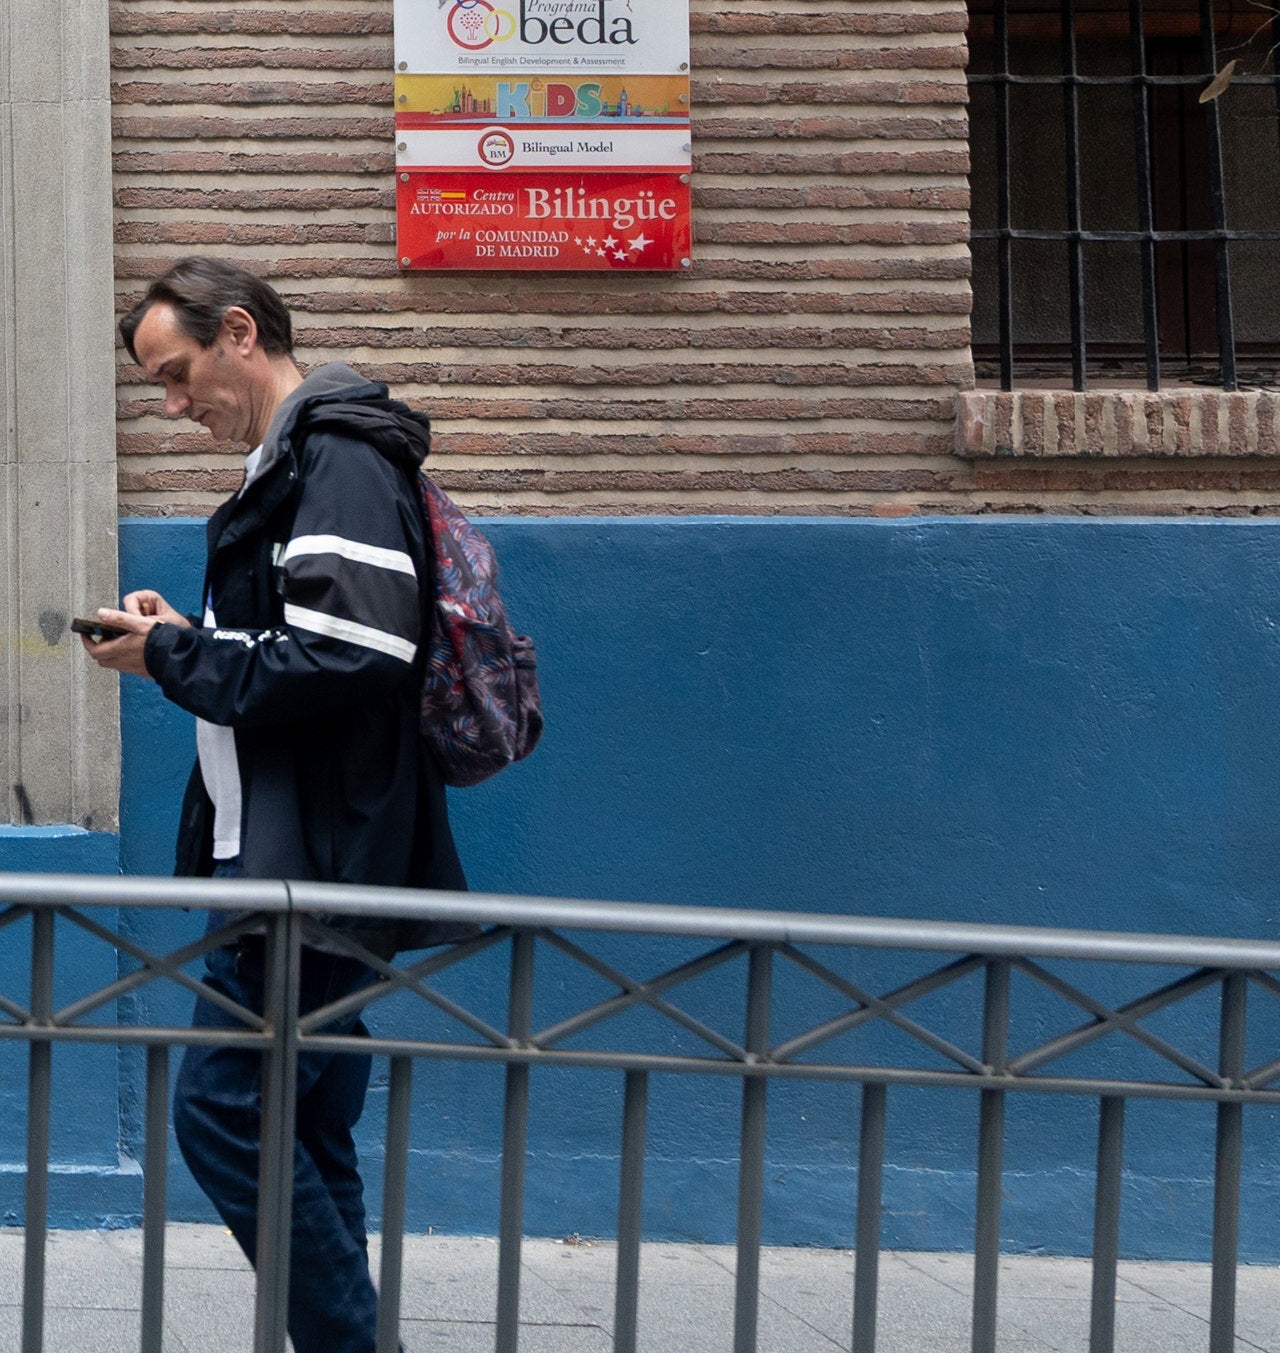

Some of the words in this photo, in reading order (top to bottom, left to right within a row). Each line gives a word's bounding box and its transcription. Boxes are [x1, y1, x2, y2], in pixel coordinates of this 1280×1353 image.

[458, 57, 489, 66] Bilingual
[492, 57, 517, 66] English
[520, 57, 571, 66] Development
[581, 57, 625, 65] Assessment
[490, 150, 507, 159] BM
[522, 142, 574, 155] Bilingual
[577, 142, 613, 153] Model
[473, 190, 515, 201] Centro
[410, 203, 513, 216] AUTORIZADO
[524, 188, 677, 230] Bilingüe
[436, 230, 456, 243] por
[459, 229, 471, 240] la
[476, 231, 569, 243] COMUNIDAD
[476, 245, 496, 257] DE
[500, 245, 559, 257] MADRID
